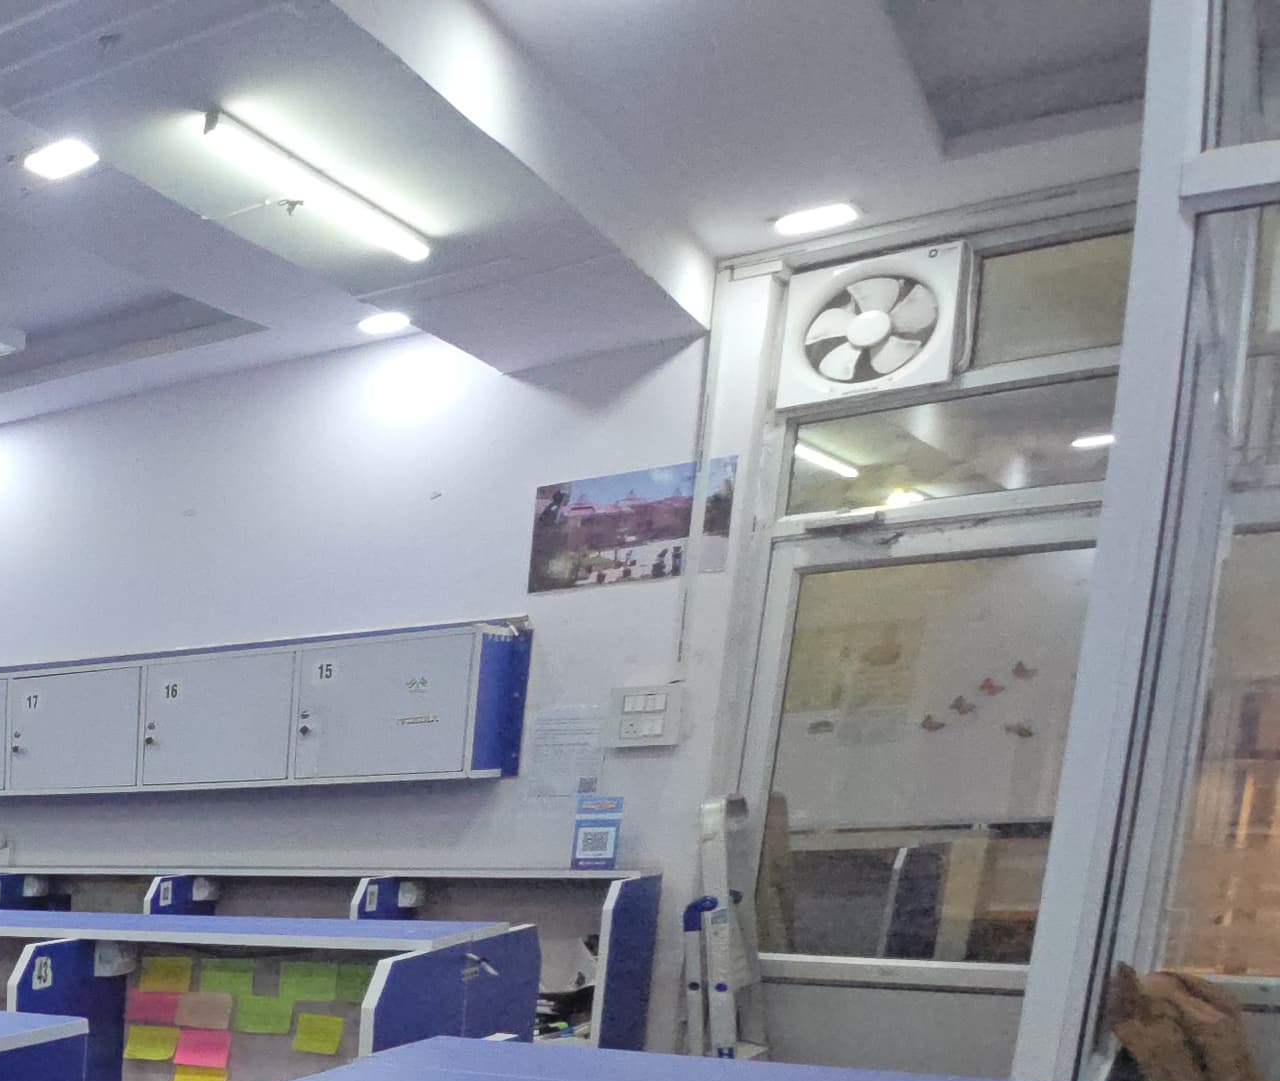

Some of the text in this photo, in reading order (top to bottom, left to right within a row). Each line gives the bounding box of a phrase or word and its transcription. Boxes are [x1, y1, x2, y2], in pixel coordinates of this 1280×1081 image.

[318, 663, 333, 680] 15
[165, 683, 178, 699] 16
[26, 694, 38, 709] 17
[37, 961, 48, 984] 43
